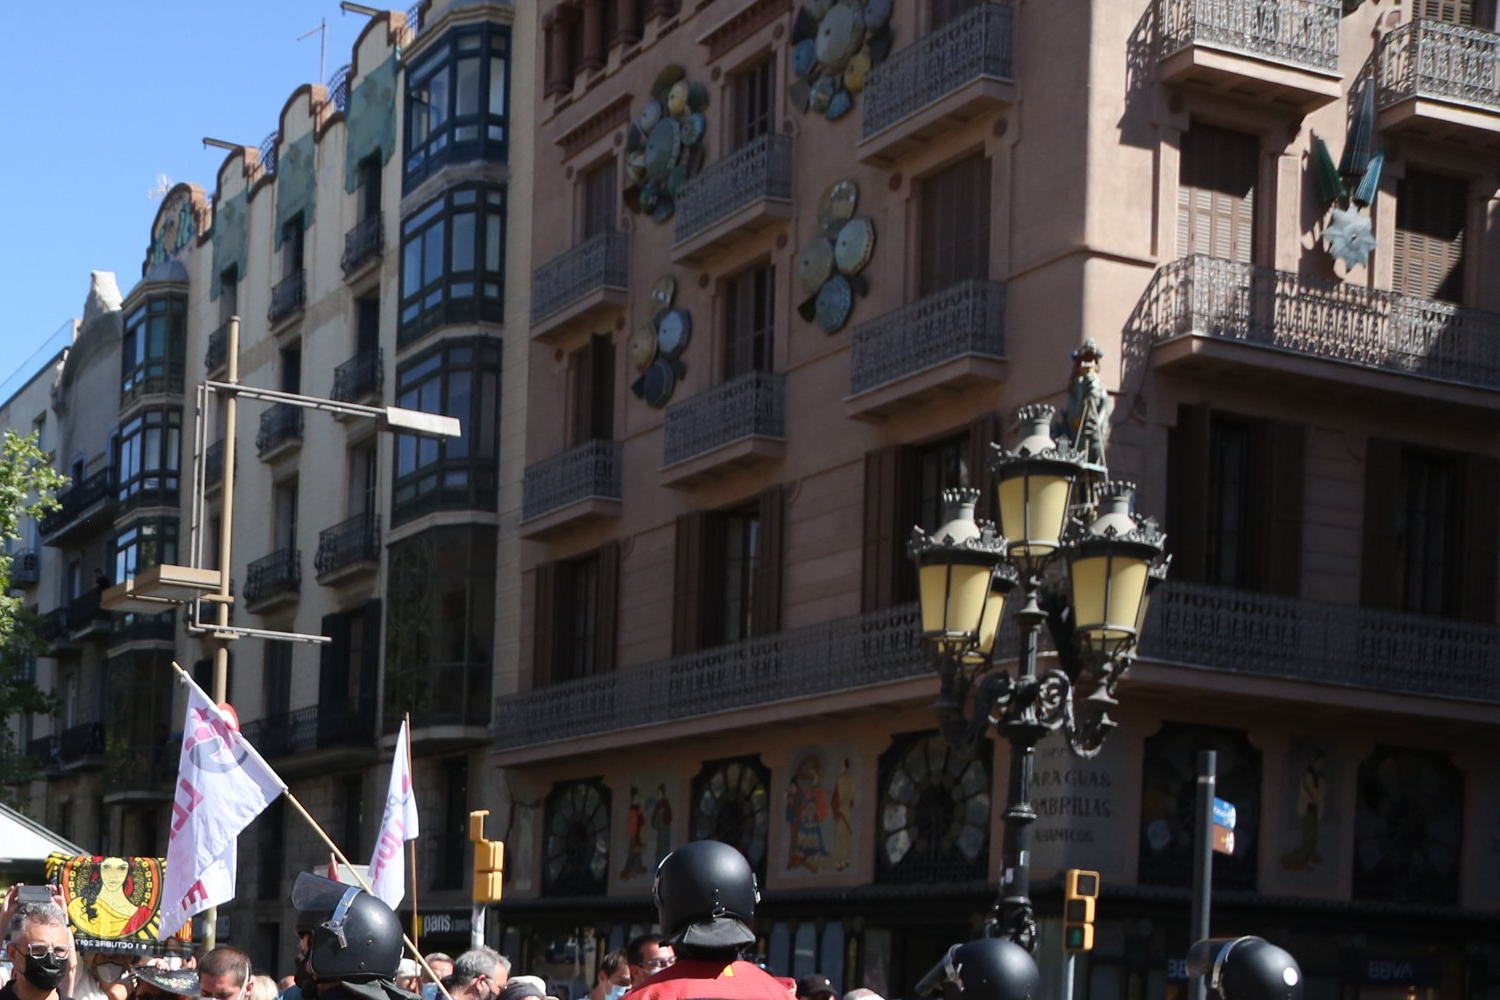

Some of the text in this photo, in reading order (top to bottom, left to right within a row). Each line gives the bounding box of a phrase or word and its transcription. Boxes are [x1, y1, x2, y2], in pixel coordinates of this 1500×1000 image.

[1032, 769, 1112, 788] ARAGUAS
[424, 914, 451, 937] pans
[1368, 961, 1412, 979] BBVA
